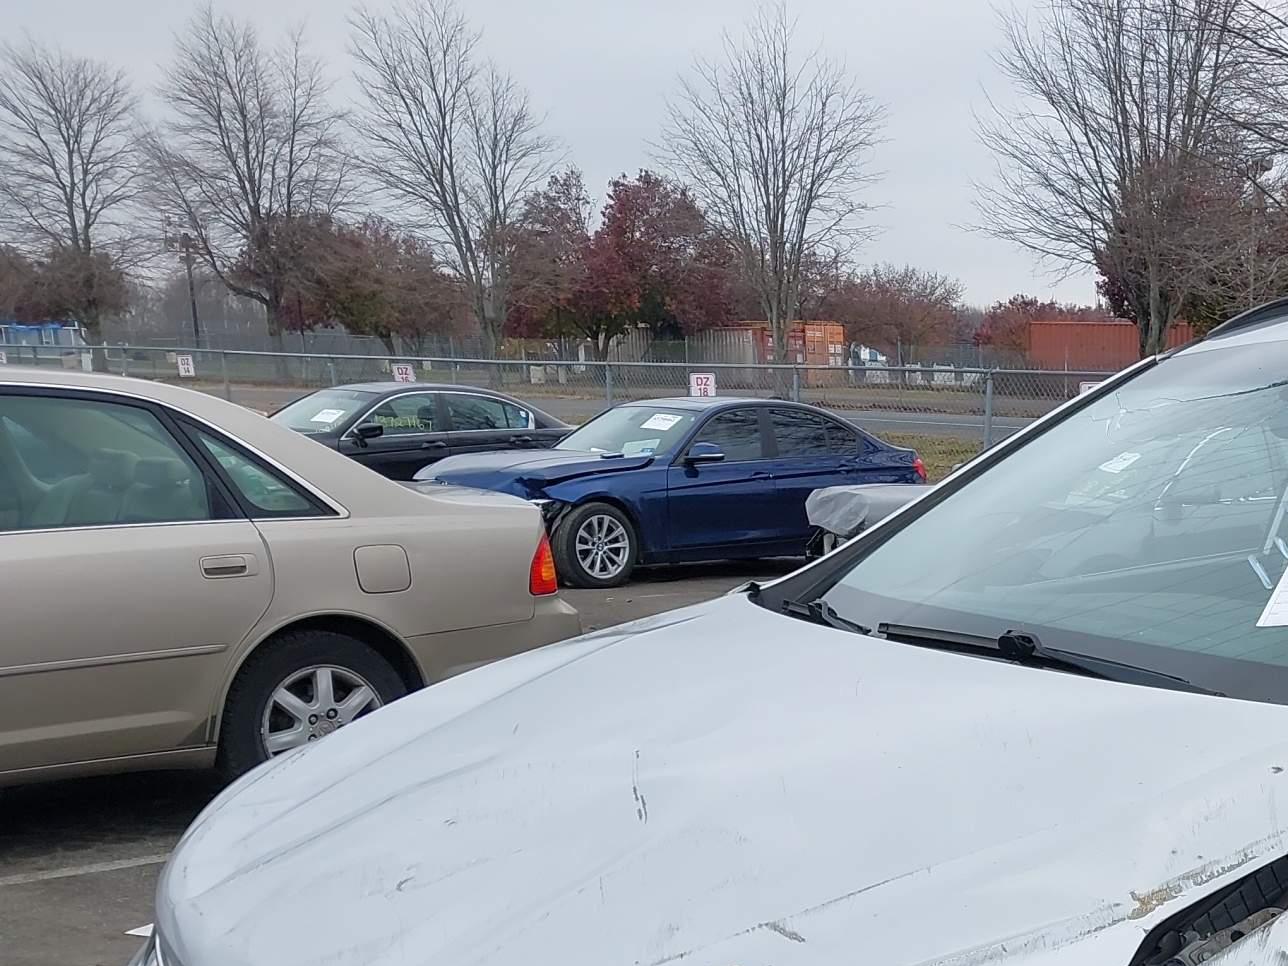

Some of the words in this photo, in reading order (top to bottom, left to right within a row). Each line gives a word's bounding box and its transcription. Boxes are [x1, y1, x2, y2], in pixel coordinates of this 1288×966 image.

[396, 367, 409, 376] DZ
[696, 377, 710, 387] DZ
[698, 387, 709, 397] 18
